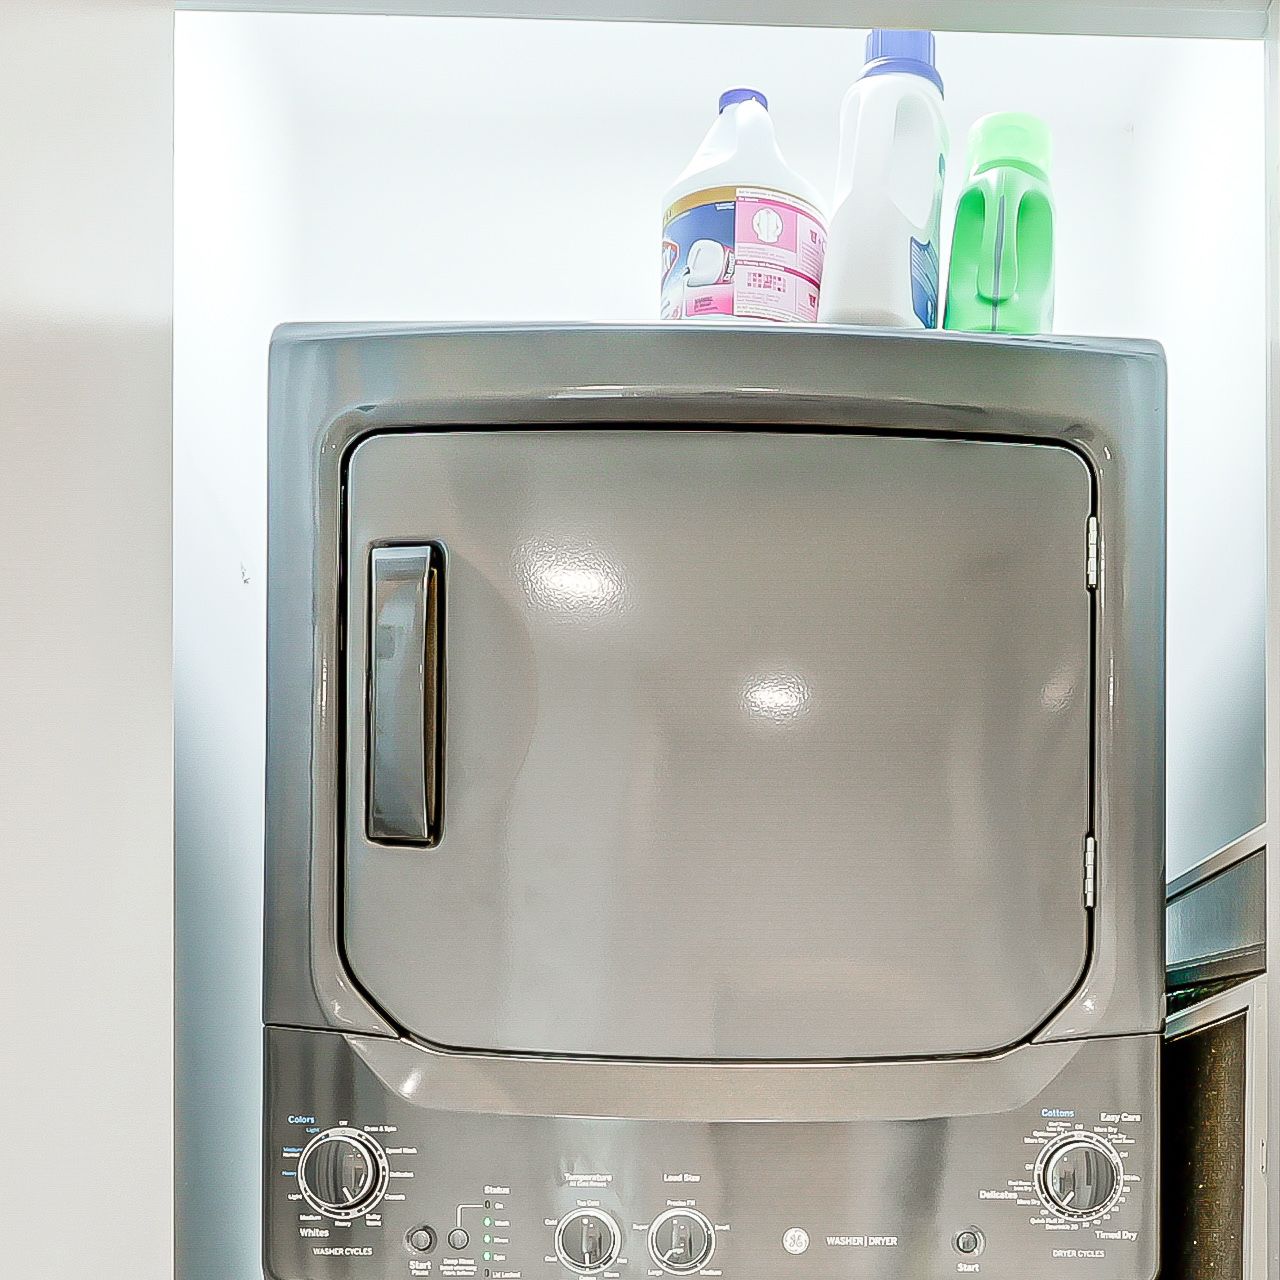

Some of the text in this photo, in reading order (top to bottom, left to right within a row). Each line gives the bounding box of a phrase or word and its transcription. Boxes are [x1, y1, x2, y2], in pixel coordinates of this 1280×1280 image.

[1041, 1108, 1075, 1117] Cottons
[288, 1115, 315, 1124] Colors
[564, 1173, 613, 1183] Temperature
[663, 1174, 682, 1182] Load
[300, 1228, 329, 1238] Whites
[1122, 1231, 1137, 1241] Dry
[345, 1247, 373, 1255] CYCLES
[409, 1260, 431, 1270] Start
[957, 1262, 980, 1272] Start
